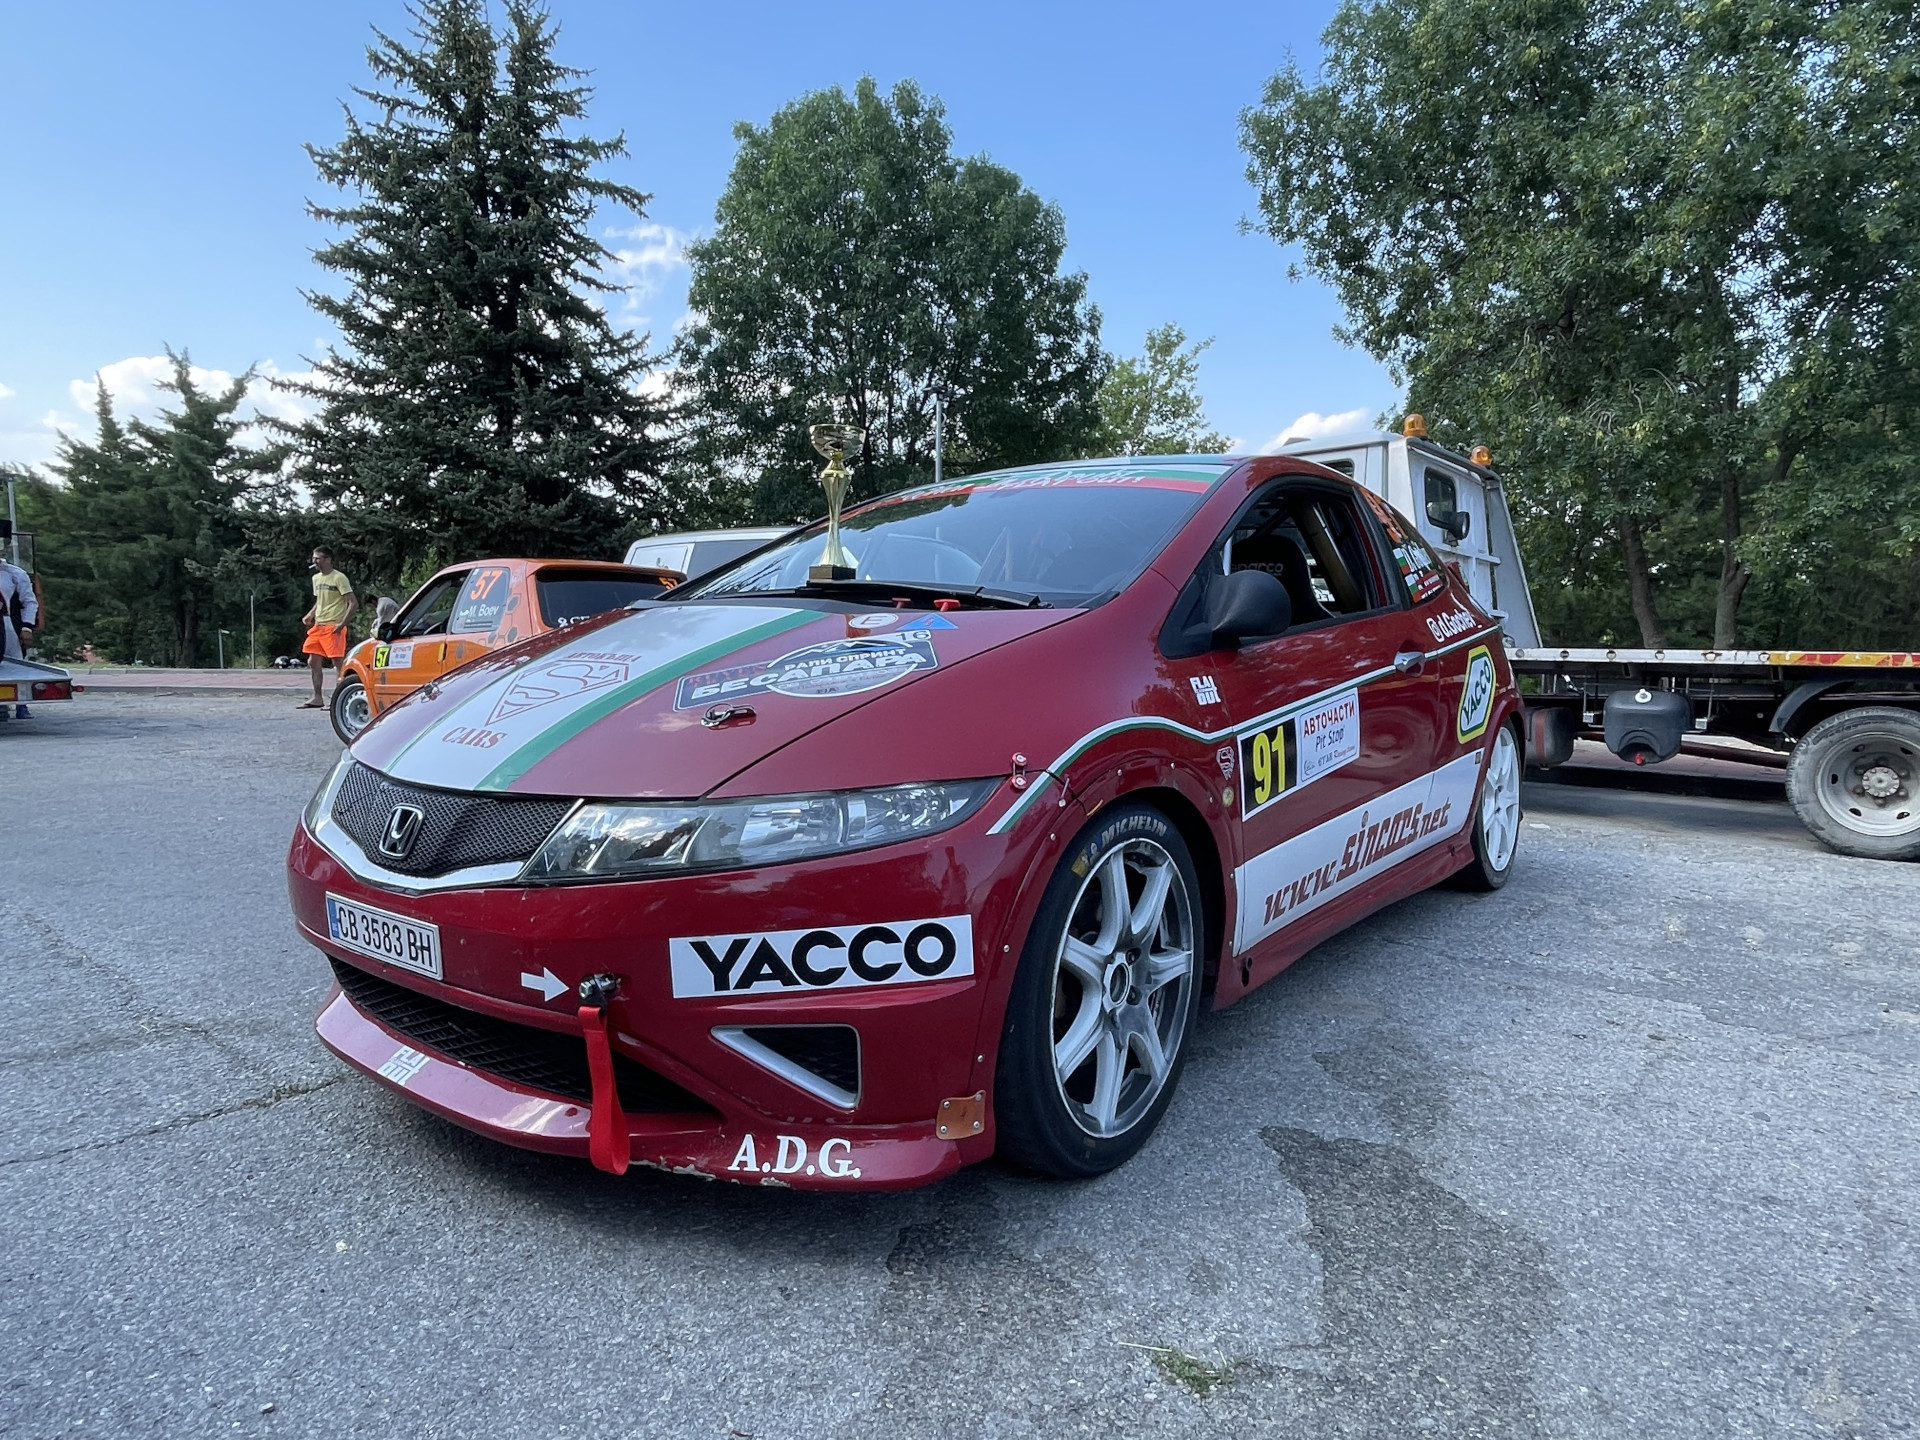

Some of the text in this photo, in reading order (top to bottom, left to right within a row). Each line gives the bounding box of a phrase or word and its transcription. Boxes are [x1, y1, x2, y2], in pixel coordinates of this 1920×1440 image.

[470, 570, 503, 600] 57
[376, 646, 390, 668] 57
[836, 648, 906, 663] СПРИНТ
[691, 652, 927, 700] БЕСАПАРА
[1461, 660, 1491, 726] YACCO
[441, 726, 508, 750] CARS
[1303, 700, 1355, 738] АВТОЧАСТИ
[1315, 727, 1344, 752] Pit Stop
[1252, 725, 1286, 804] 91
[1101, 815, 1167, 848] MICHELIN
[338, 906, 433, 969] CB 3583 BH
[689, 922, 957, 992] YACCO
[727, 1133, 862, 1178] A.D.G.
